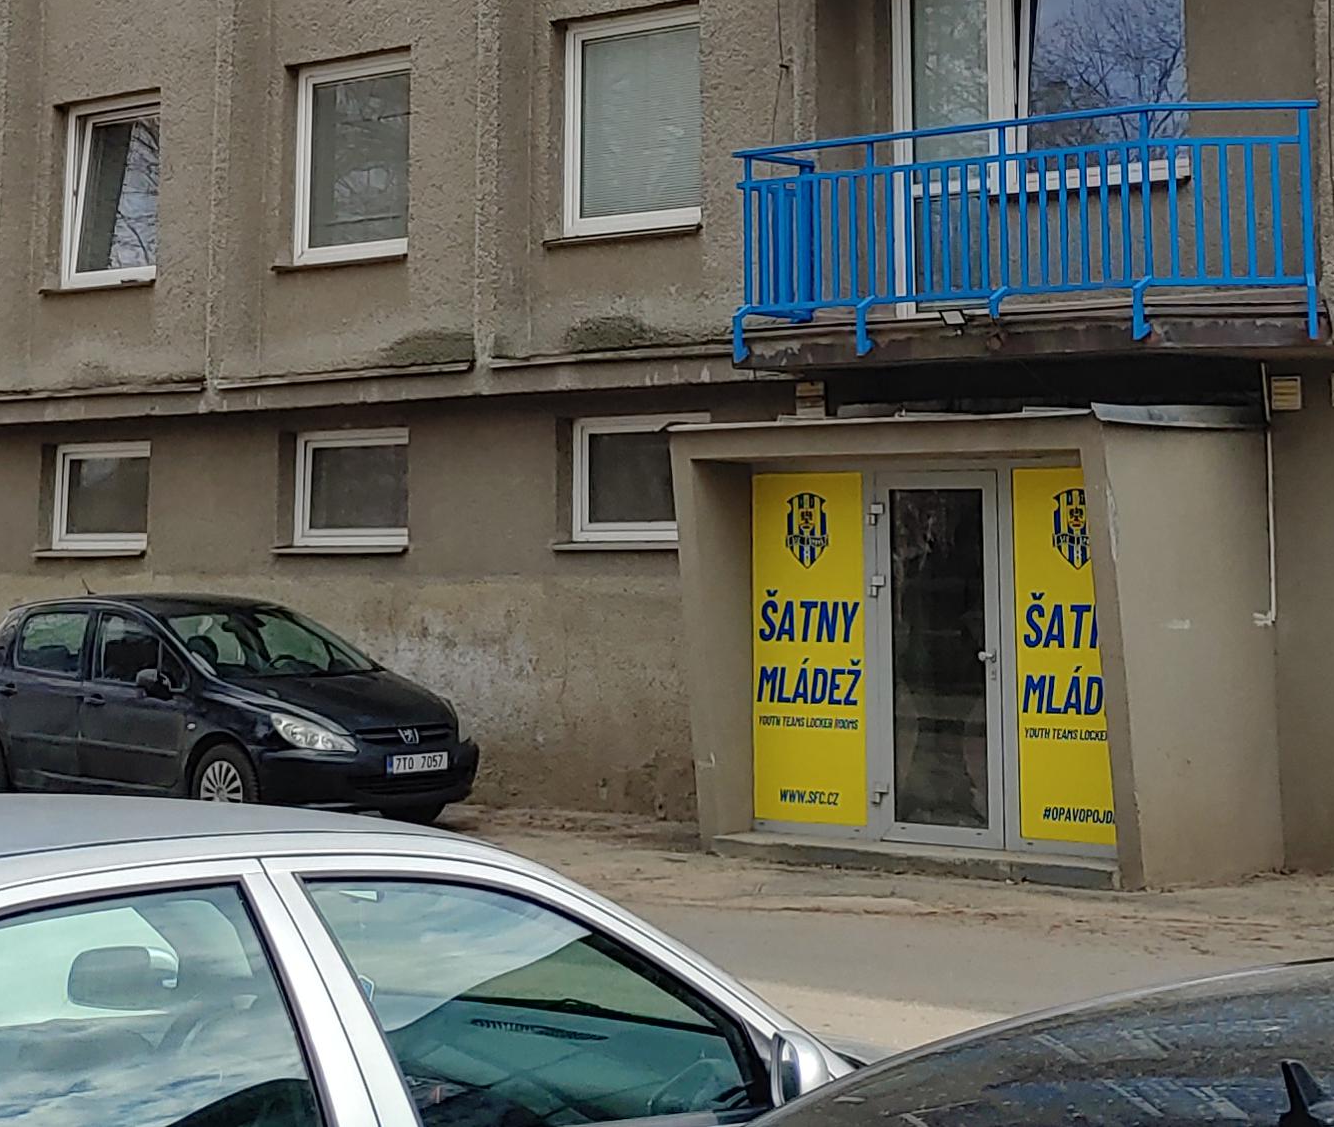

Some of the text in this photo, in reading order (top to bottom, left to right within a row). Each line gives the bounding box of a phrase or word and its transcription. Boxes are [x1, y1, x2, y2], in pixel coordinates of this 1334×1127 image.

[759, 589, 860, 644] ŠATNY
[756, 658, 862, 706] MLÁDEŽ
[1022, 665, 1105, 717] MLÁD
[759, 716, 859, 730] YOUTH TEAMS LOCKER ROOMS
[1025, 727, 1107, 741] YOUTH TEAMS LOCKE
[420, 754, 443, 769] 7057
[780, 788, 839, 805] WWW.SFC.CZ
[1043, 806, 1115, 824] #OPAVOPOJD
